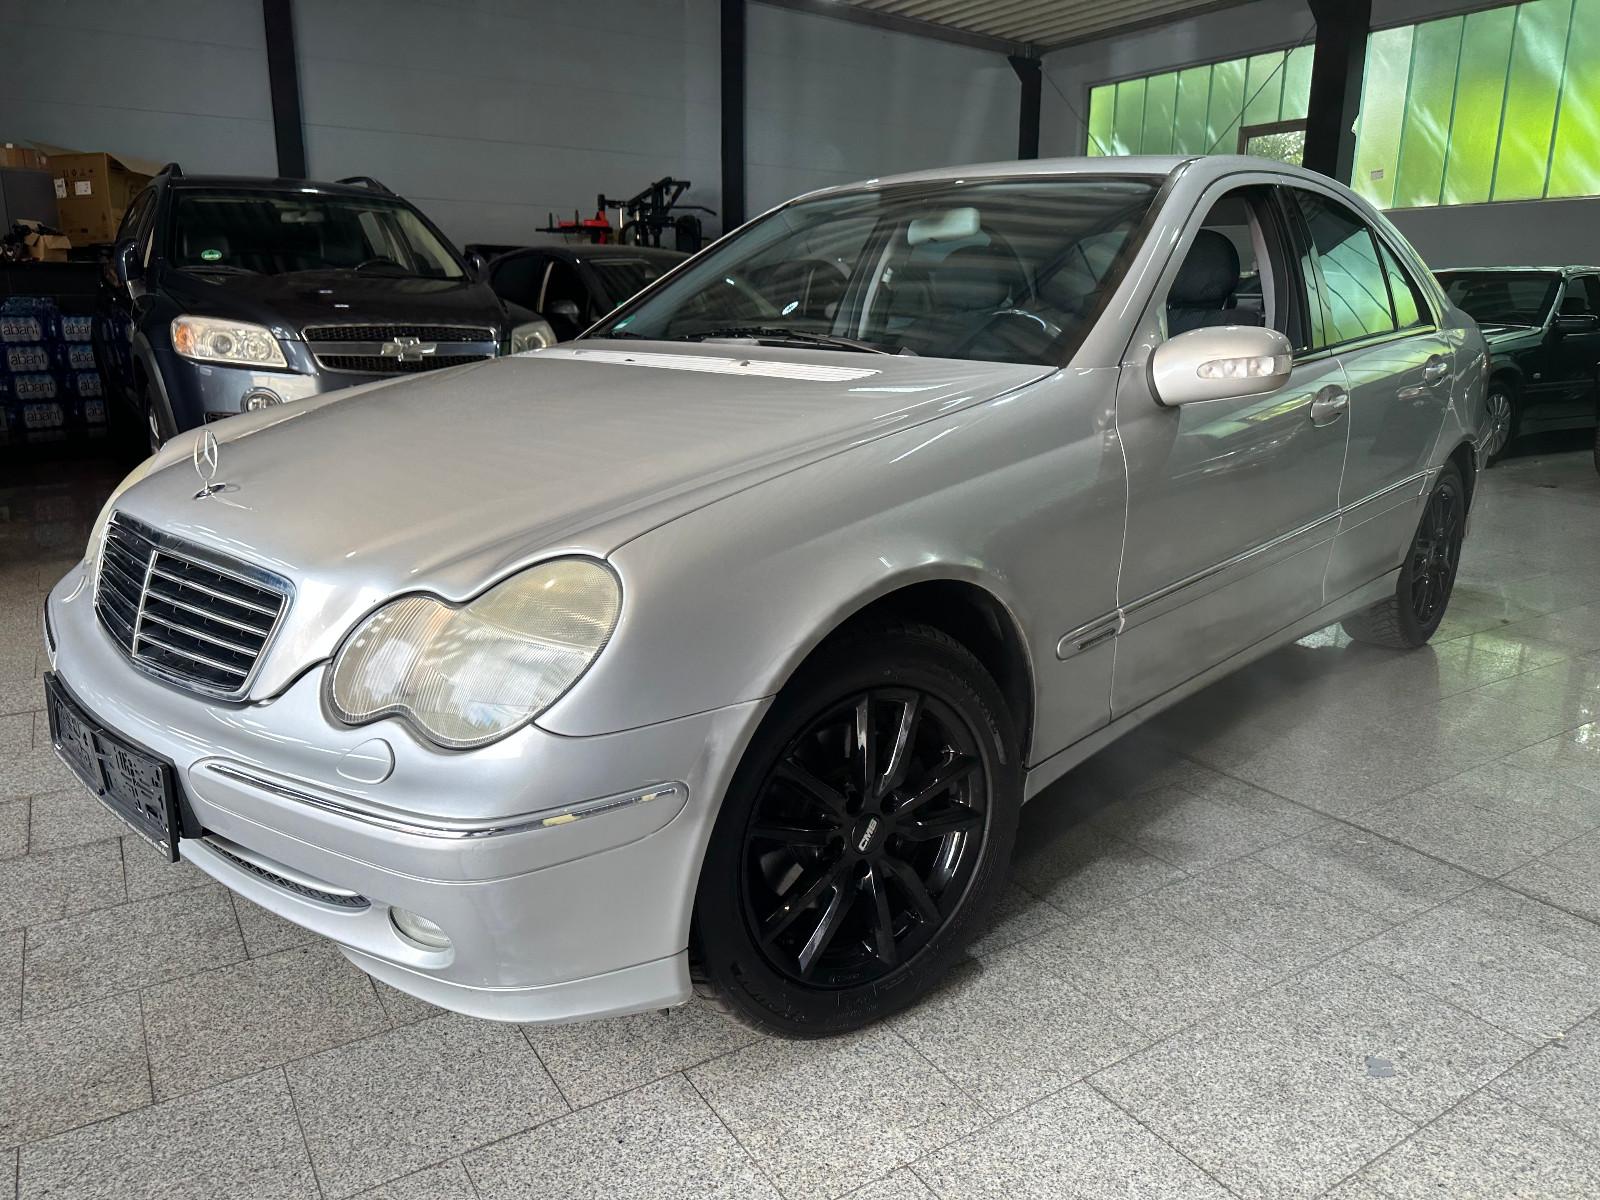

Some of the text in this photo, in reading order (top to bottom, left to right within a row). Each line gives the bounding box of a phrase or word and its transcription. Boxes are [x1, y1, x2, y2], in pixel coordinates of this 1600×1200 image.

[4, 323, 38, 336] abant
[11, 351, 44, 365] abant
[72, 351, 94, 363] aba
[18, 380, 53, 393] abant
[27, 408, 59, 422] abant
